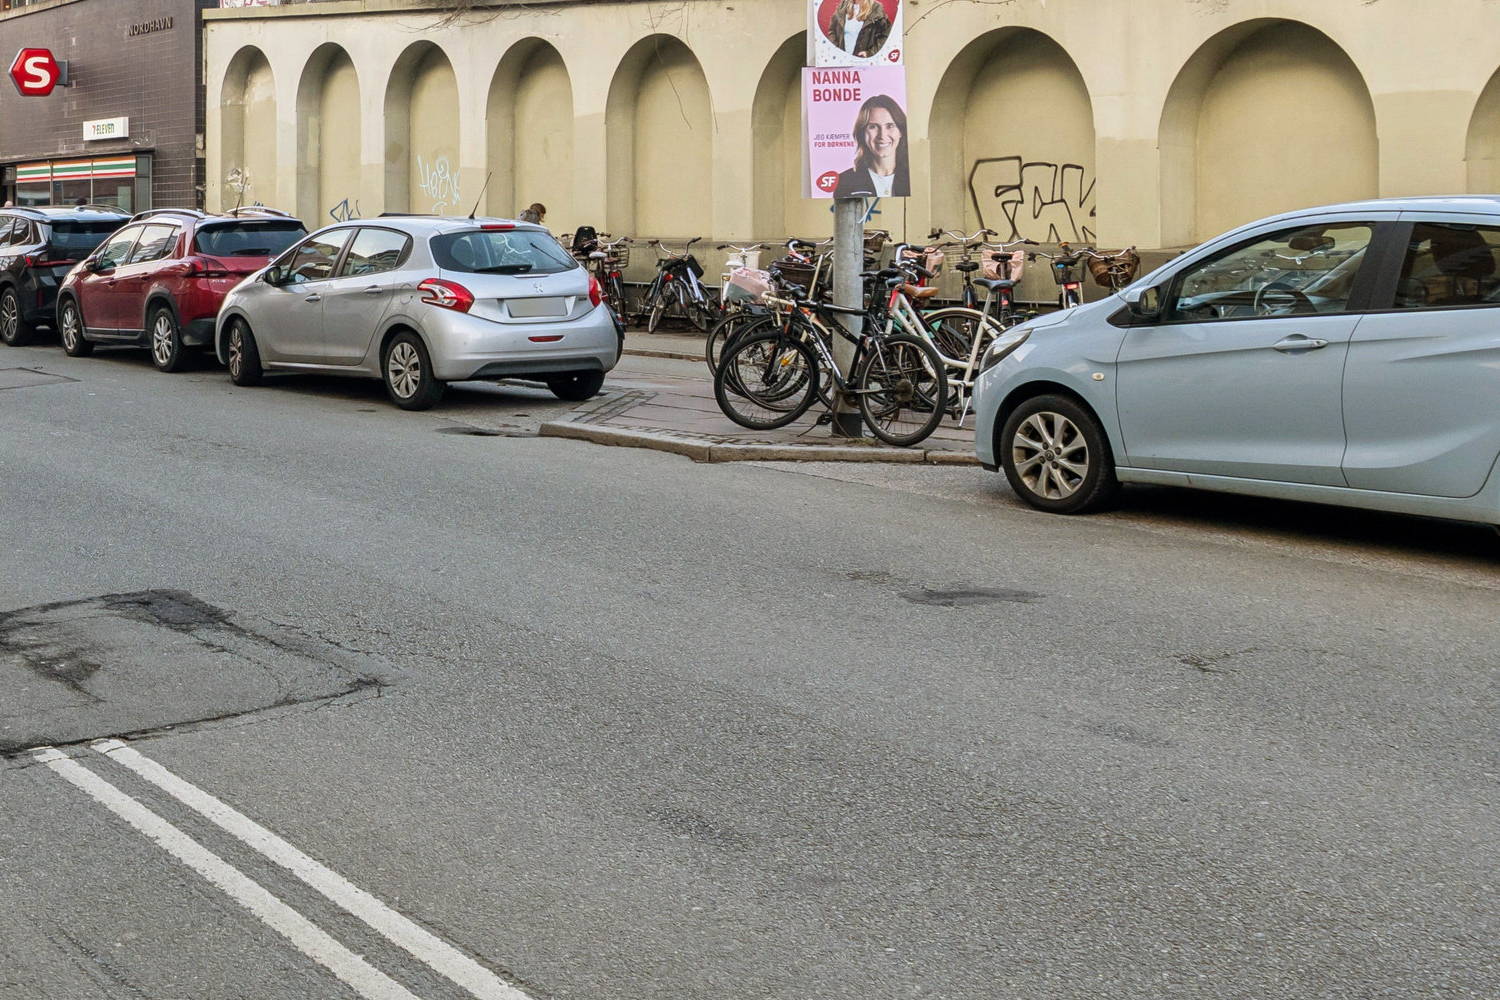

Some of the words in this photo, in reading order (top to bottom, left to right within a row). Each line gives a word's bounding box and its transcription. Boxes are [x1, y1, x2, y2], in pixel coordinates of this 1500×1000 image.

[129, 16, 173, 36] NORDHAVN
[890, 52, 900, 60] SF
[24, 56, 51, 88] S
[812, 70, 861, 85] NANNA
[813, 88, 861, 102] BONDE
[820, 176, 837, 188] SF
